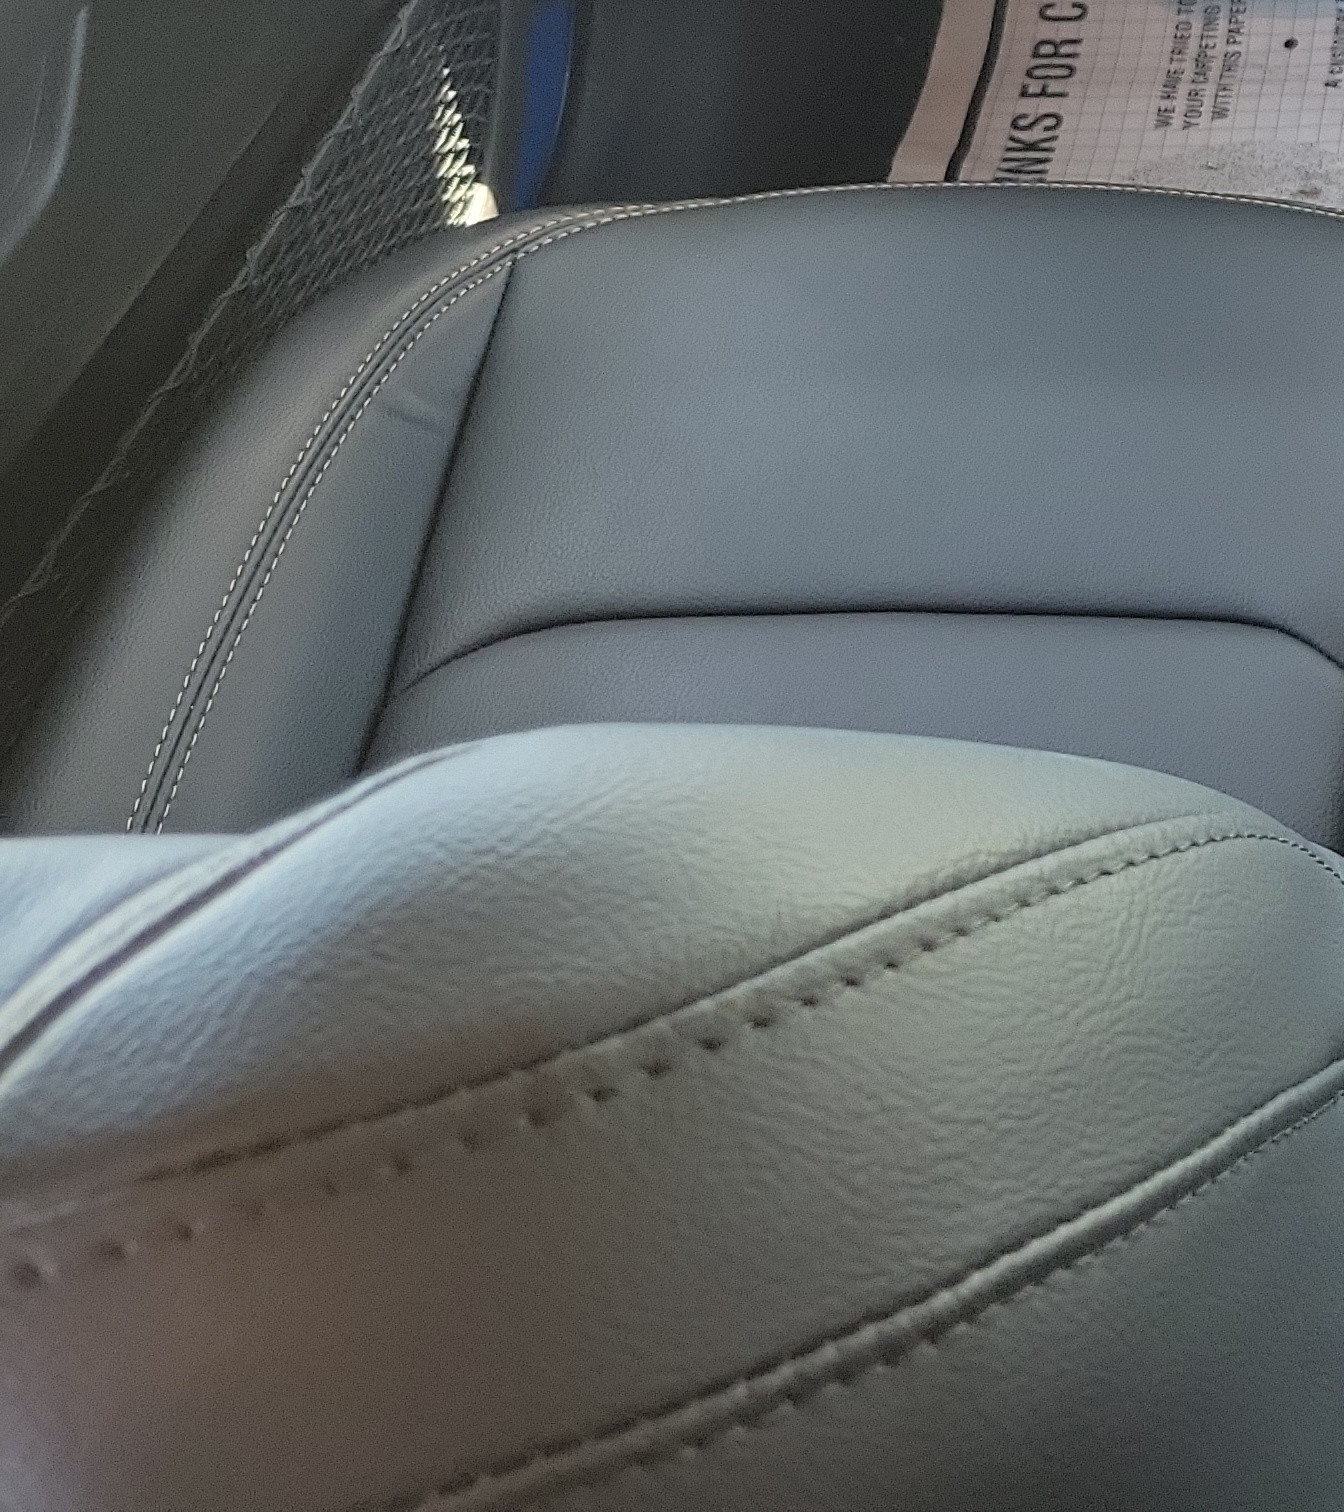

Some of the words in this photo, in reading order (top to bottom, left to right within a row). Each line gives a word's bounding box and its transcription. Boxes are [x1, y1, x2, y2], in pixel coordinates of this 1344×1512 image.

[1167, 20, 1194, 65] TRIED
[1018, 38, 1082, 98] FOR
[1158, 68, 1186, 102] HAVE
[1323, 79, 1343, 90] A
[1153, 106, 1176, 129] WE
[1182, 88, 1207, 131] YOUR
